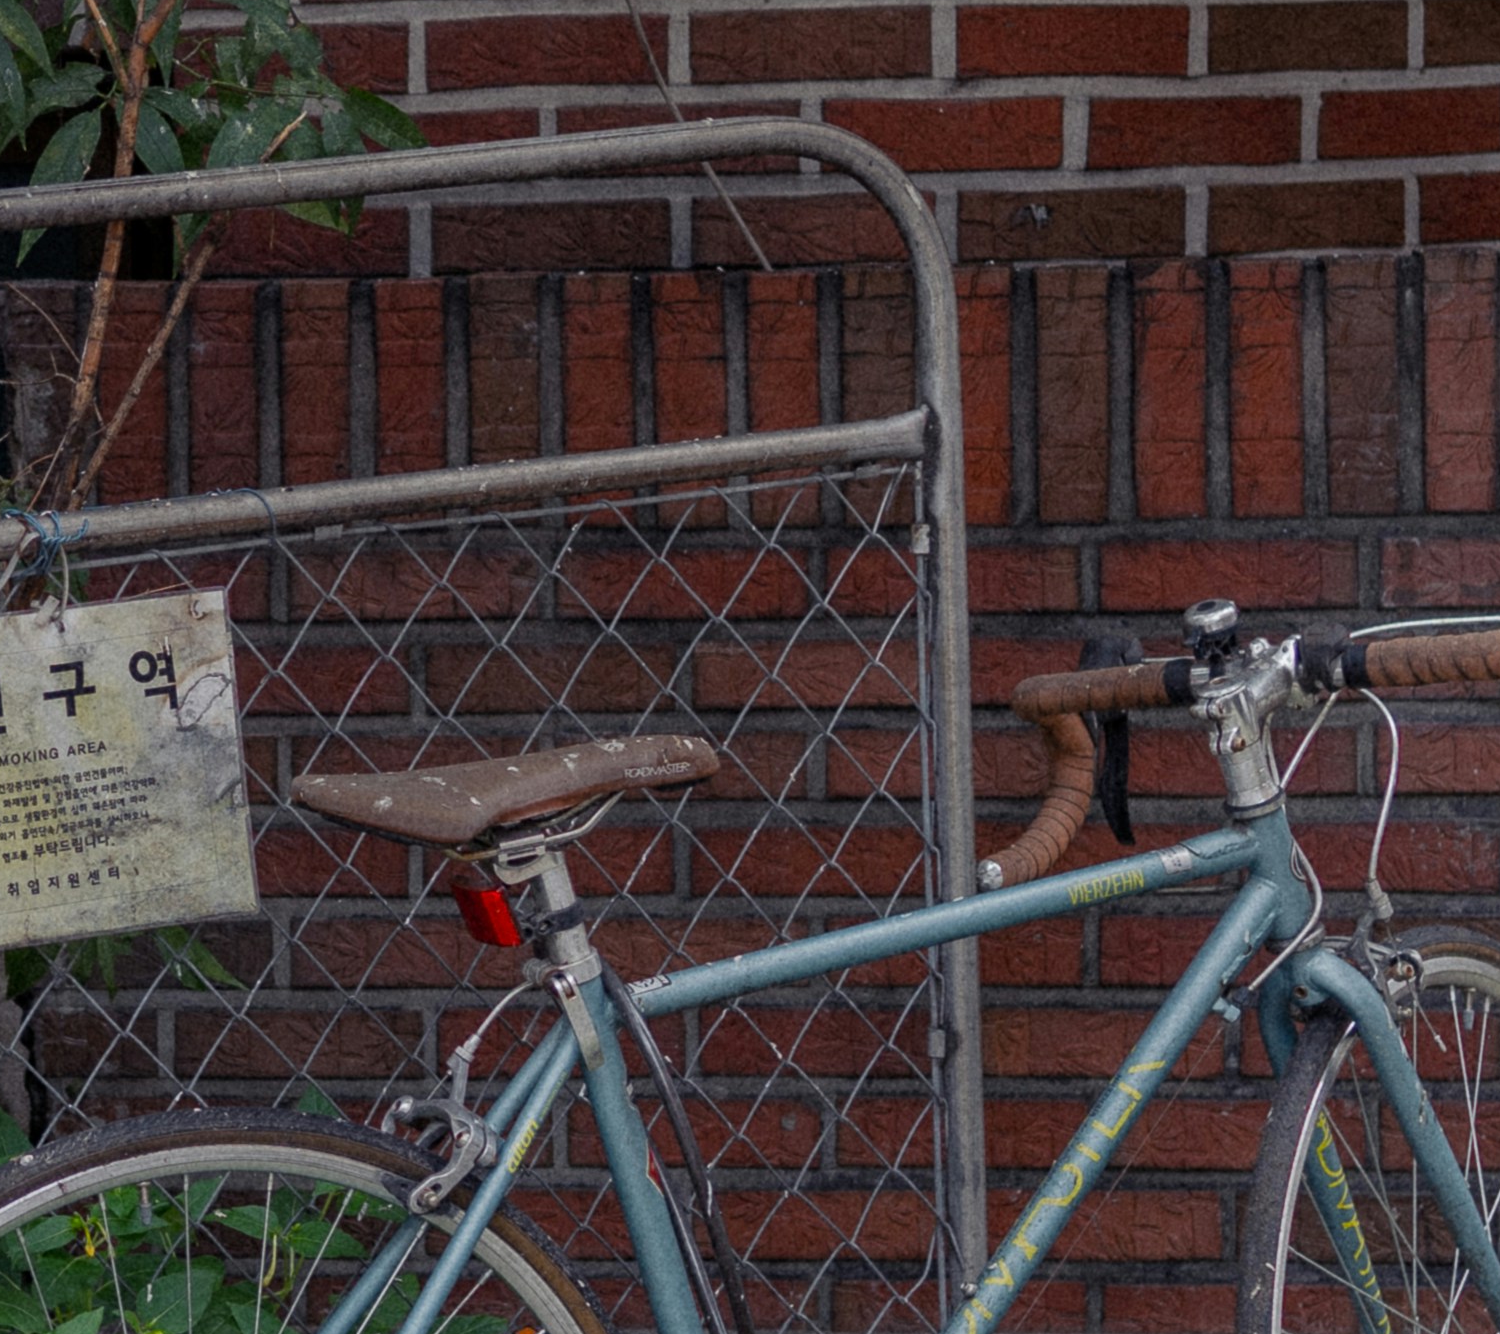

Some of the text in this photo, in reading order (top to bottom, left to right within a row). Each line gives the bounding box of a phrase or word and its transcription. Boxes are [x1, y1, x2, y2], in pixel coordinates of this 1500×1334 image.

[67, 740, 107, 757] AREA
[624, 762, 691, 778] ROADMASTER
[1067, 868, 1145, 906] VIERZEHN
